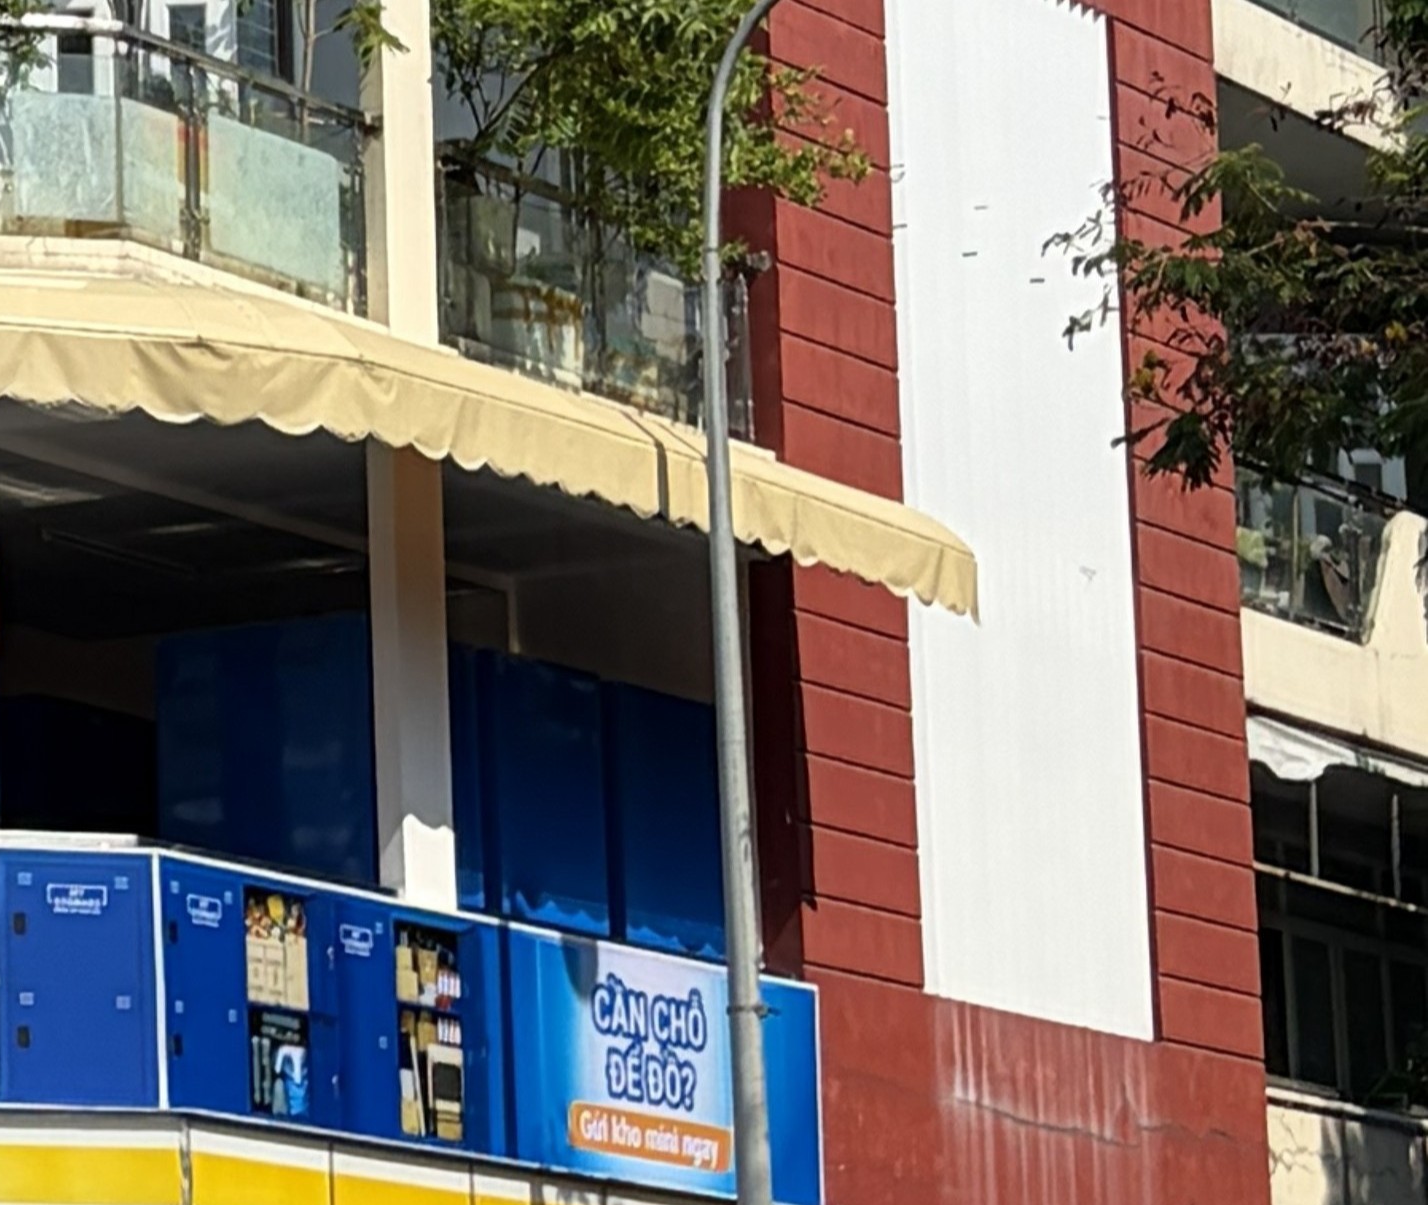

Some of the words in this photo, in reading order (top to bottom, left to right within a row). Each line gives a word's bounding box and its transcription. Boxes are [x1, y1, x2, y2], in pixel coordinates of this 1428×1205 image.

[594, 975, 646, 1037] CẦN
[654, 991, 705, 1049] CHỖ
[609, 1042, 642, 1097] ĐỂ
[579, 1109, 610, 1142] Gửi
[611, 1114, 642, 1148] kho
[645, 1124, 680, 1154] mini
[682, 1134, 719, 1170] ngay
